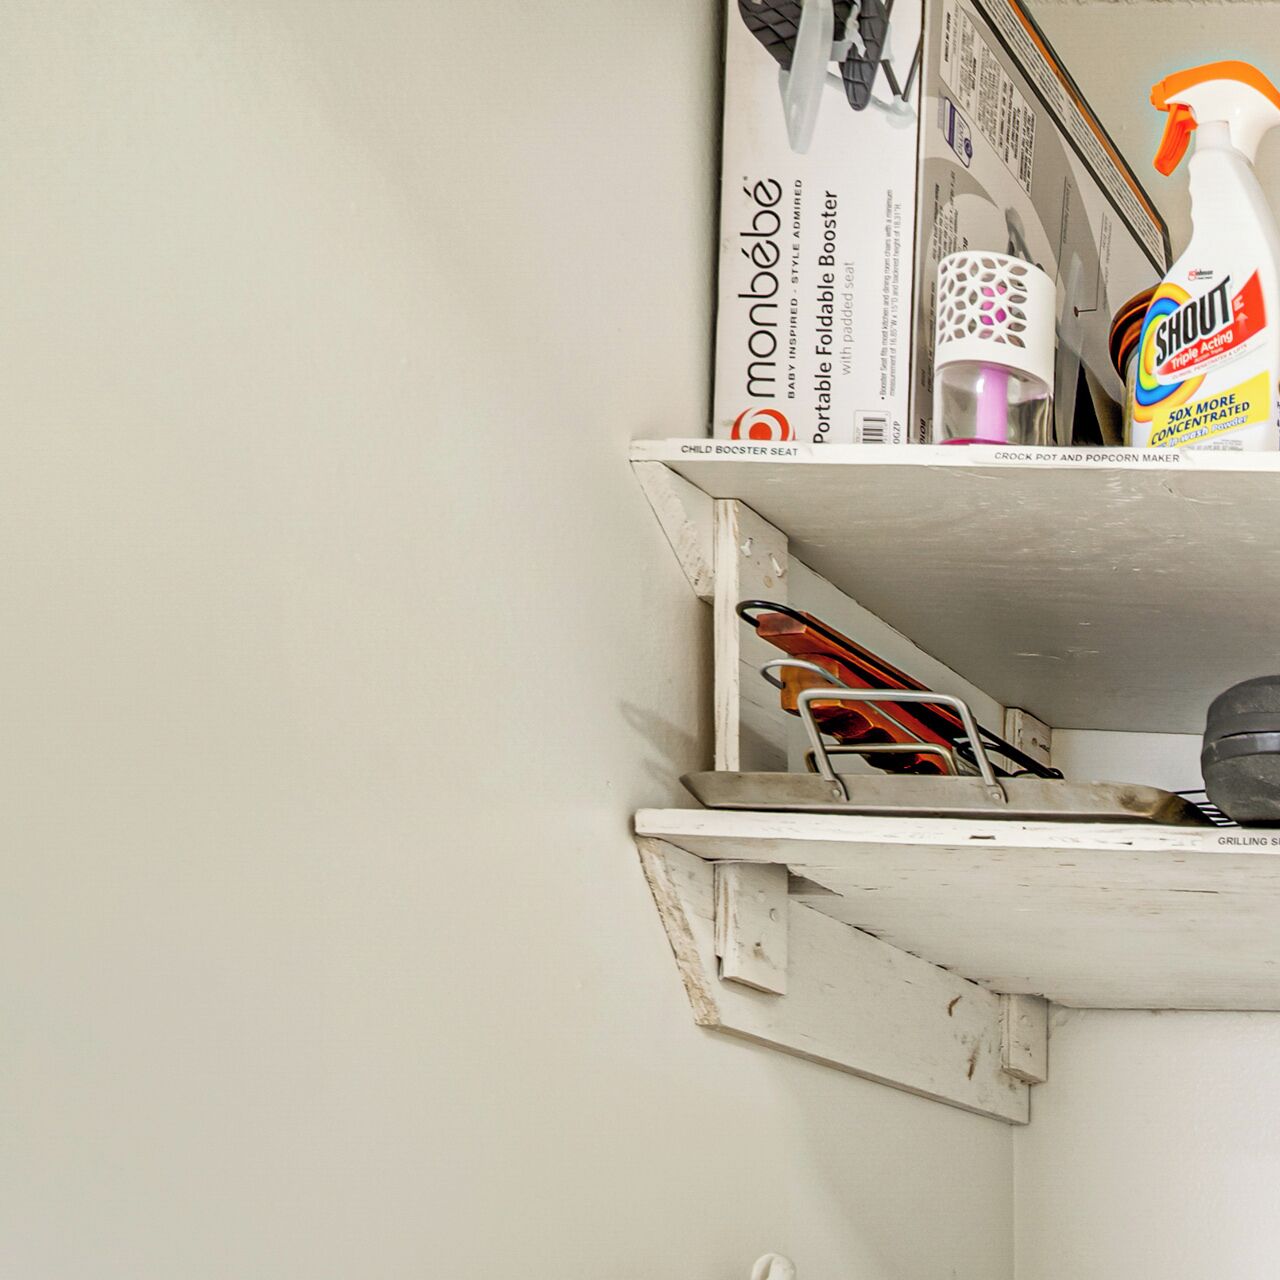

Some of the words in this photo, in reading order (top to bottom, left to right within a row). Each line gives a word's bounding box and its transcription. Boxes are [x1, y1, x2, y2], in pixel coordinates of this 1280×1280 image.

[793, 179, 802, 239] ADMIRED
[818, 190, 838, 266] Booster
[792, 243, 801, 284] STYLE
[843, 261, 855, 289] seat
[737, 178, 782, 398] monbébé
[788, 298, 798, 359] INSPIRED
[815, 272, 834, 355] Foldable
[840, 293, 855, 343] padded
[1156, 275, 1231, 367] SHOUT
[841, 346, 853, 376] with
[1171, 346, 1198, 370] Triple
[1200, 329, 1234, 353] Acting
[787, 363, 796, 399] BABY
[813, 362, 832, 444] Portable
[1151, 401, 1250, 445] CONCENTRATED
[1168, 406, 1193, 425] 50X
[1195, 394, 1237, 417] MORE
[681, 445, 713, 454] CHILD
[715, 446, 768, 455] BOOSTER
[770, 447, 799, 456] SEAT
[994, 452, 1033, 461] CROCK
[1036, 453, 1057, 462] POT
[1060, 453, 1083, 462] AND
[1085, 454, 1139, 463] POPCORN
[1142, 454, 1180, 463] MAKER
[1218, 837, 1268, 846] GRILLING
